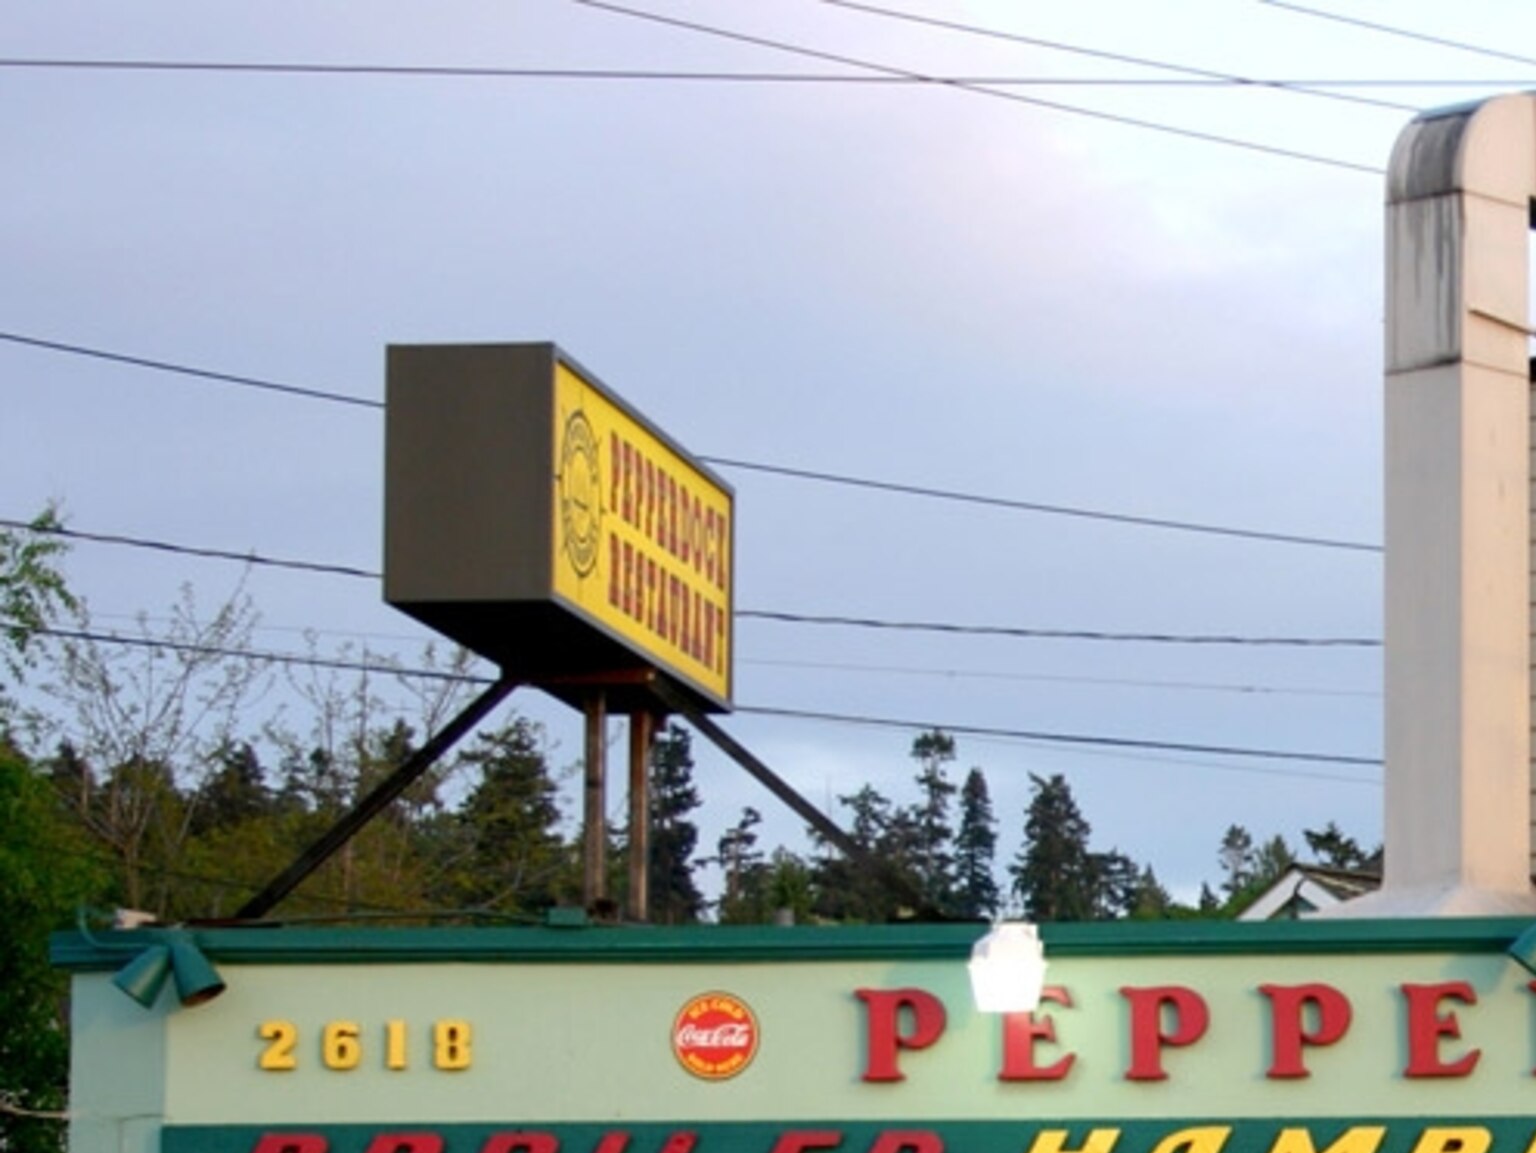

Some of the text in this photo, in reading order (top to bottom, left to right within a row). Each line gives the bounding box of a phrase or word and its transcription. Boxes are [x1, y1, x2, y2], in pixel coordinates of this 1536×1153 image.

[609, 429, 727, 593] PEPPERDOCK
[607, 531, 726, 677] RESTAURANT
[257, 1018, 475, 1071] 2618
[675, 1021, 750, 1049] Coca-Cola
